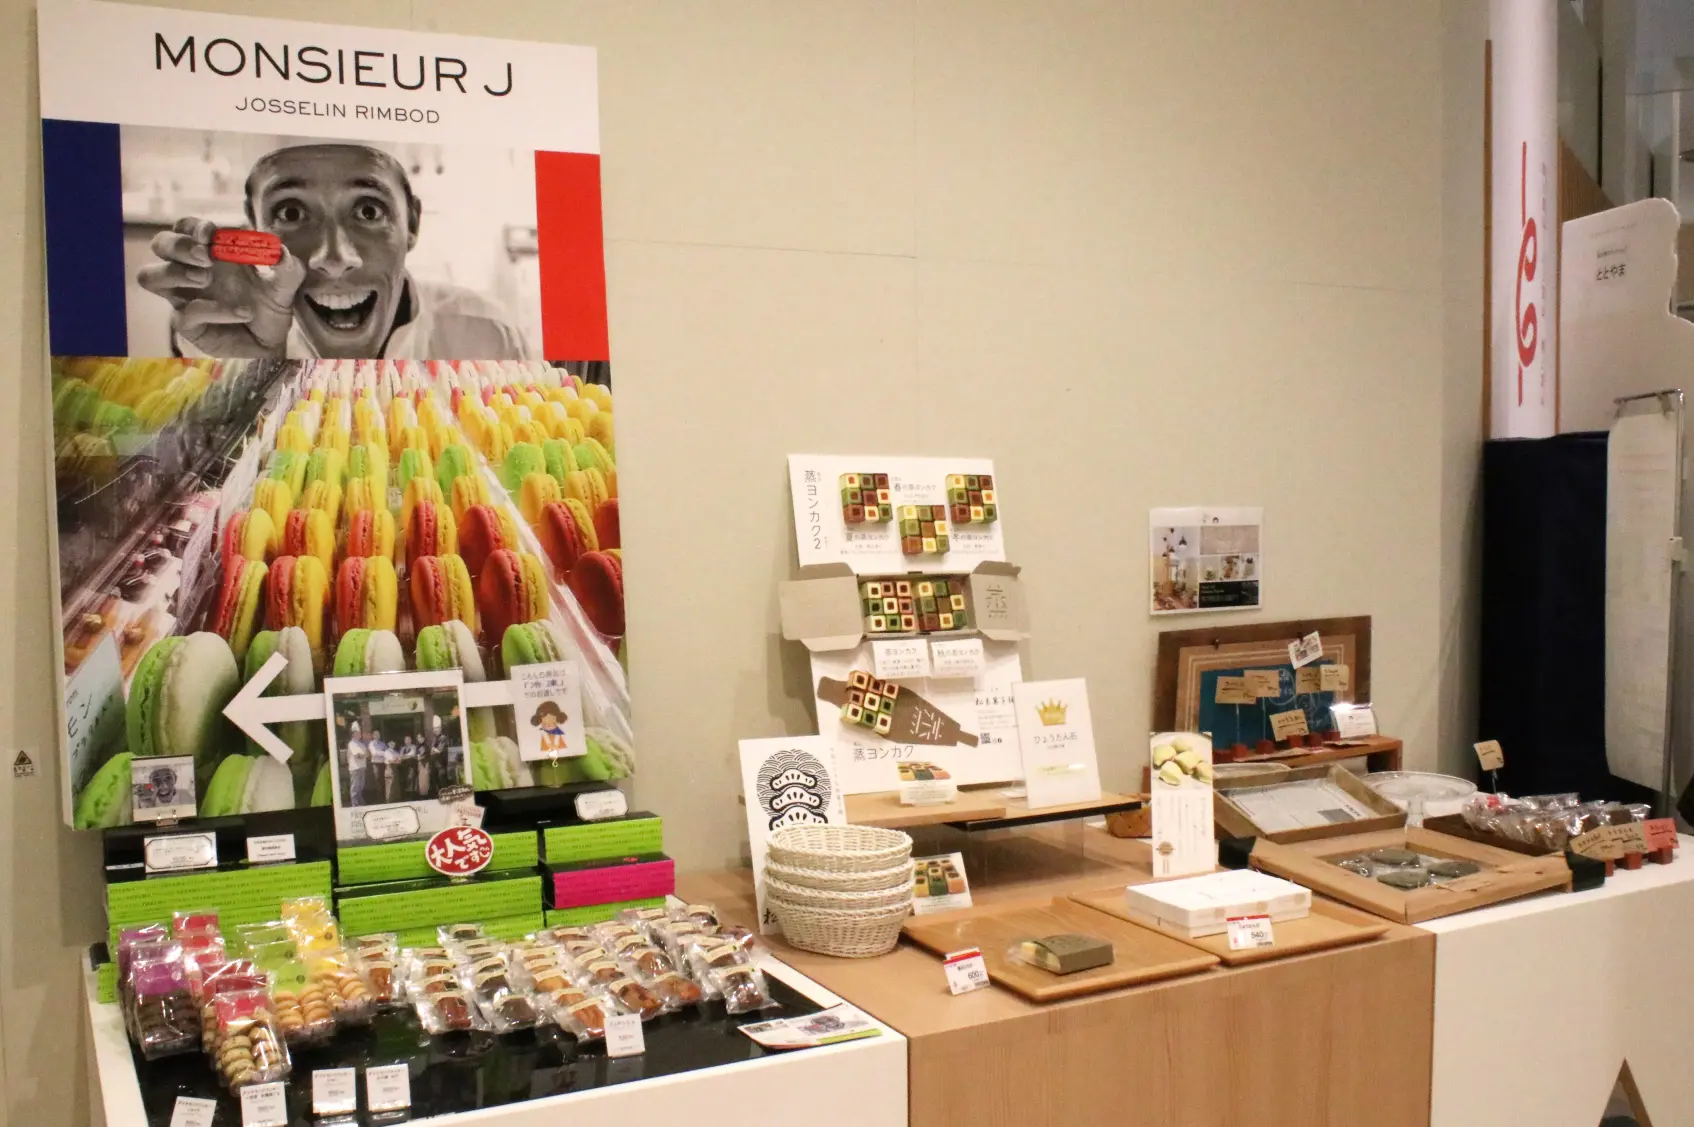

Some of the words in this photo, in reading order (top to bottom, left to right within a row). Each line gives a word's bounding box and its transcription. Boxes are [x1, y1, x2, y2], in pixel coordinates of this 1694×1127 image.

[155, 32, 468, 93] MONSIEUR
[484, 62, 513, 97] J
[235, 97, 346, 119] JOSSELIN
[355, 105, 440, 124] RIMBOD
[1595, 264, 1628, 283] ととやま
[431, 828, 488, 868] 大人気
